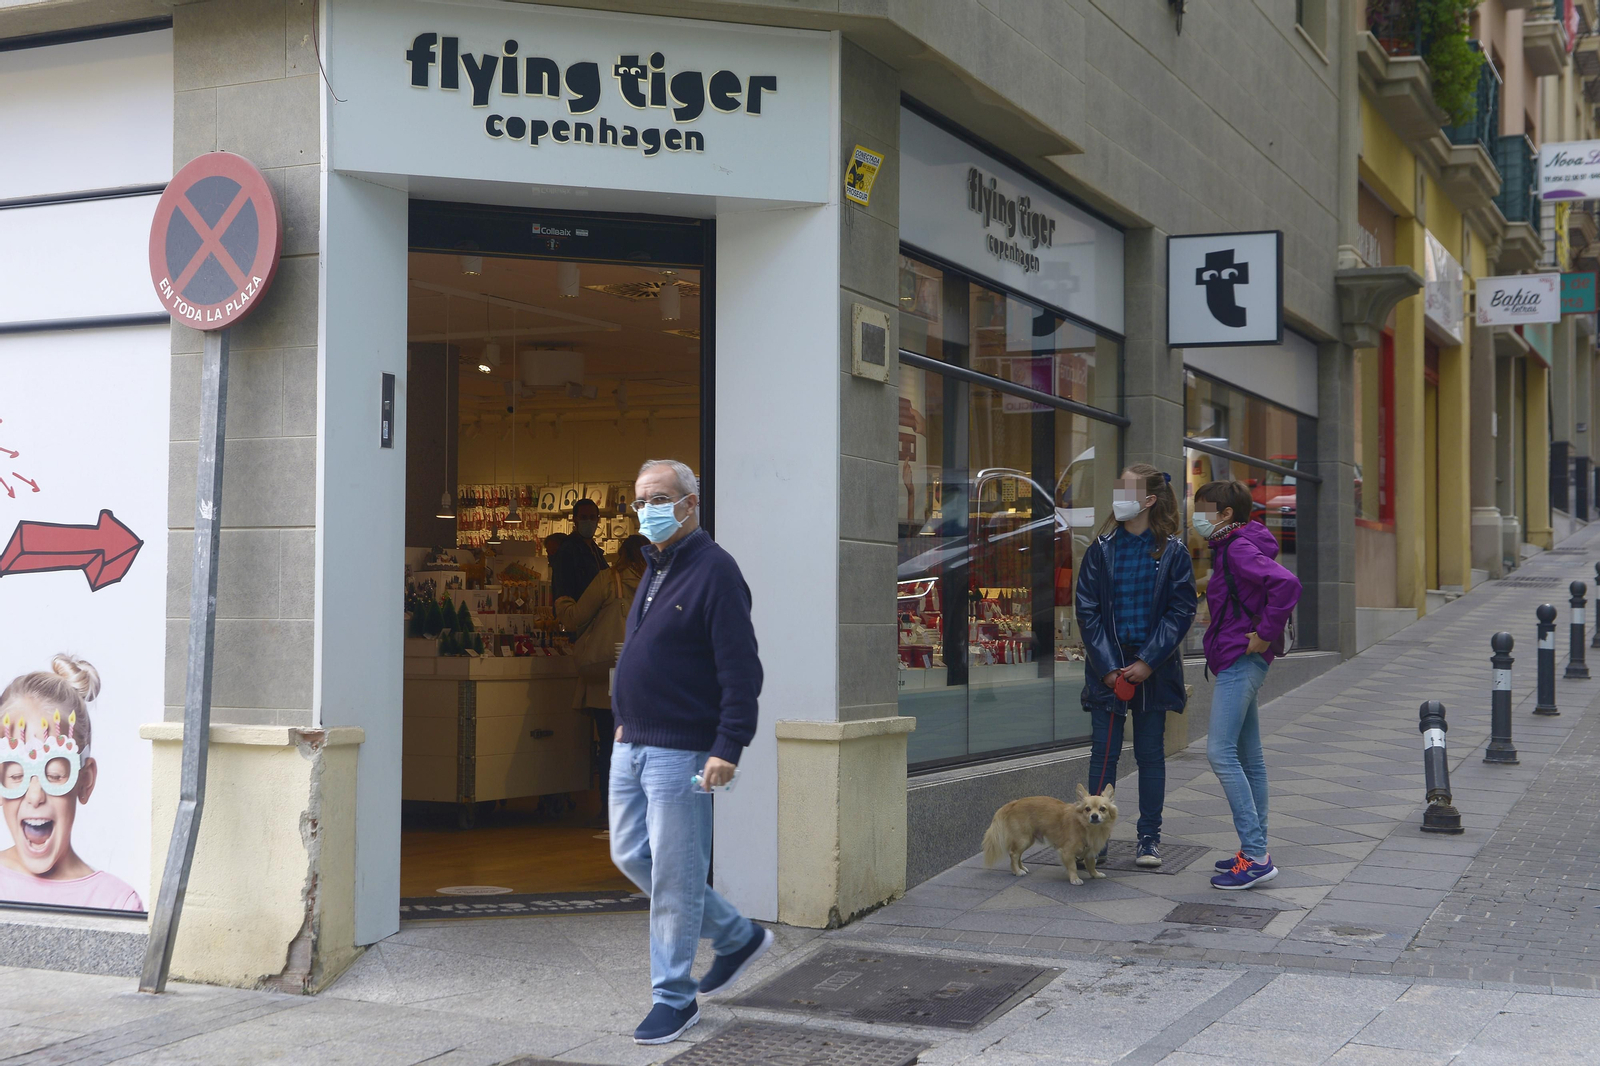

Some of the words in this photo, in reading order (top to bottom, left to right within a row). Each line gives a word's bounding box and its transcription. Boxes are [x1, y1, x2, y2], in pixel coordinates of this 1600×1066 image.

[405, 32, 601, 115] flying
[612, 52, 778, 122] tiger
[484, 113, 705, 157] copenhagen
[1545, 151, 1583, 168] Nova
[846, 187, 868, 201] PROSEGUR
[967, 167, 1016, 239] flying
[1018, 196, 1056, 249] tiger
[986, 233, 1040, 274] copenhagen
[158, 277, 174, 300] EN
[173, 296, 202, 322] TODA
[206, 308, 223, 322] LA
[225, 275, 263, 316] PLAZA
[1490, 288, 1542, 307] Bahía
